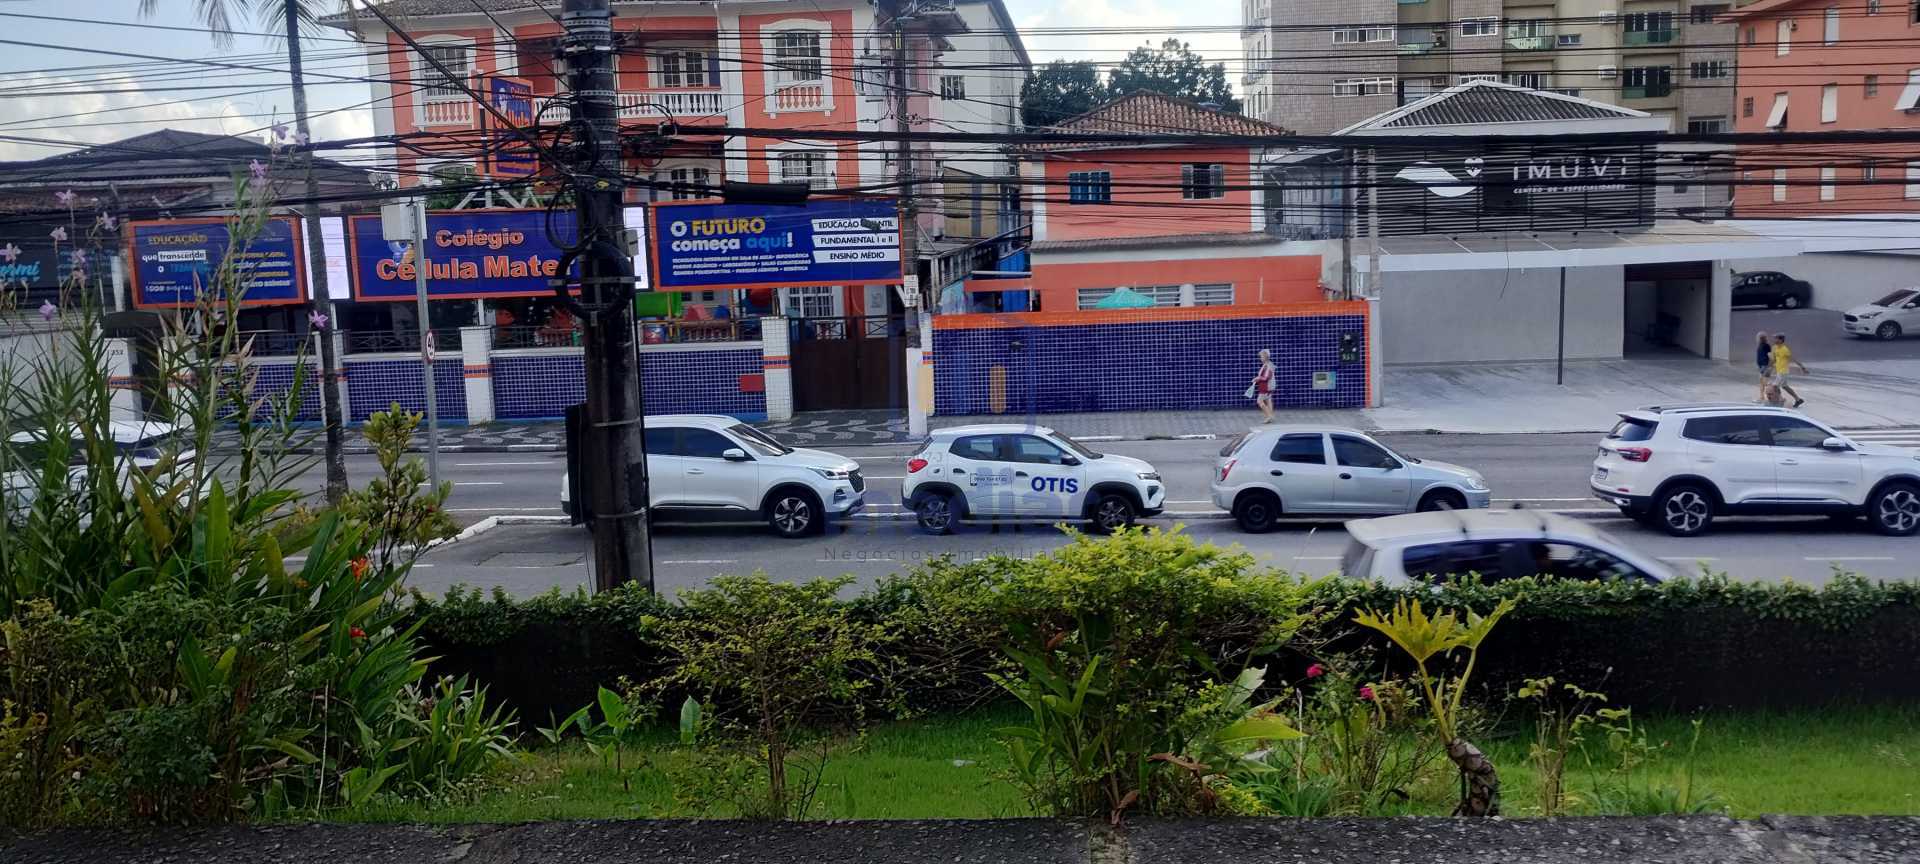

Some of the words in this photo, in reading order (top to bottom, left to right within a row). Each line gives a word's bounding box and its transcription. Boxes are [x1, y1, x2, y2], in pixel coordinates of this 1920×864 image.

[670, 220, 688, 238] O
[691, 217, 766, 237] FUTURO
[818, 219, 860, 229] EDUCAÇÃO
[435, 228, 524, 250] Colégio
[671, 237, 741, 254] começa
[746, 231, 793, 252] aqui!
[820, 236, 875, 245] FUNDAMENTAL
[141, 254, 159, 263] que
[159, 252, 206, 261] transcende
[829, 252, 859, 260] ENSINO
[860, 250, 886, 259] MÉDIO
[1030, 475, 1079, 495] OTIS
